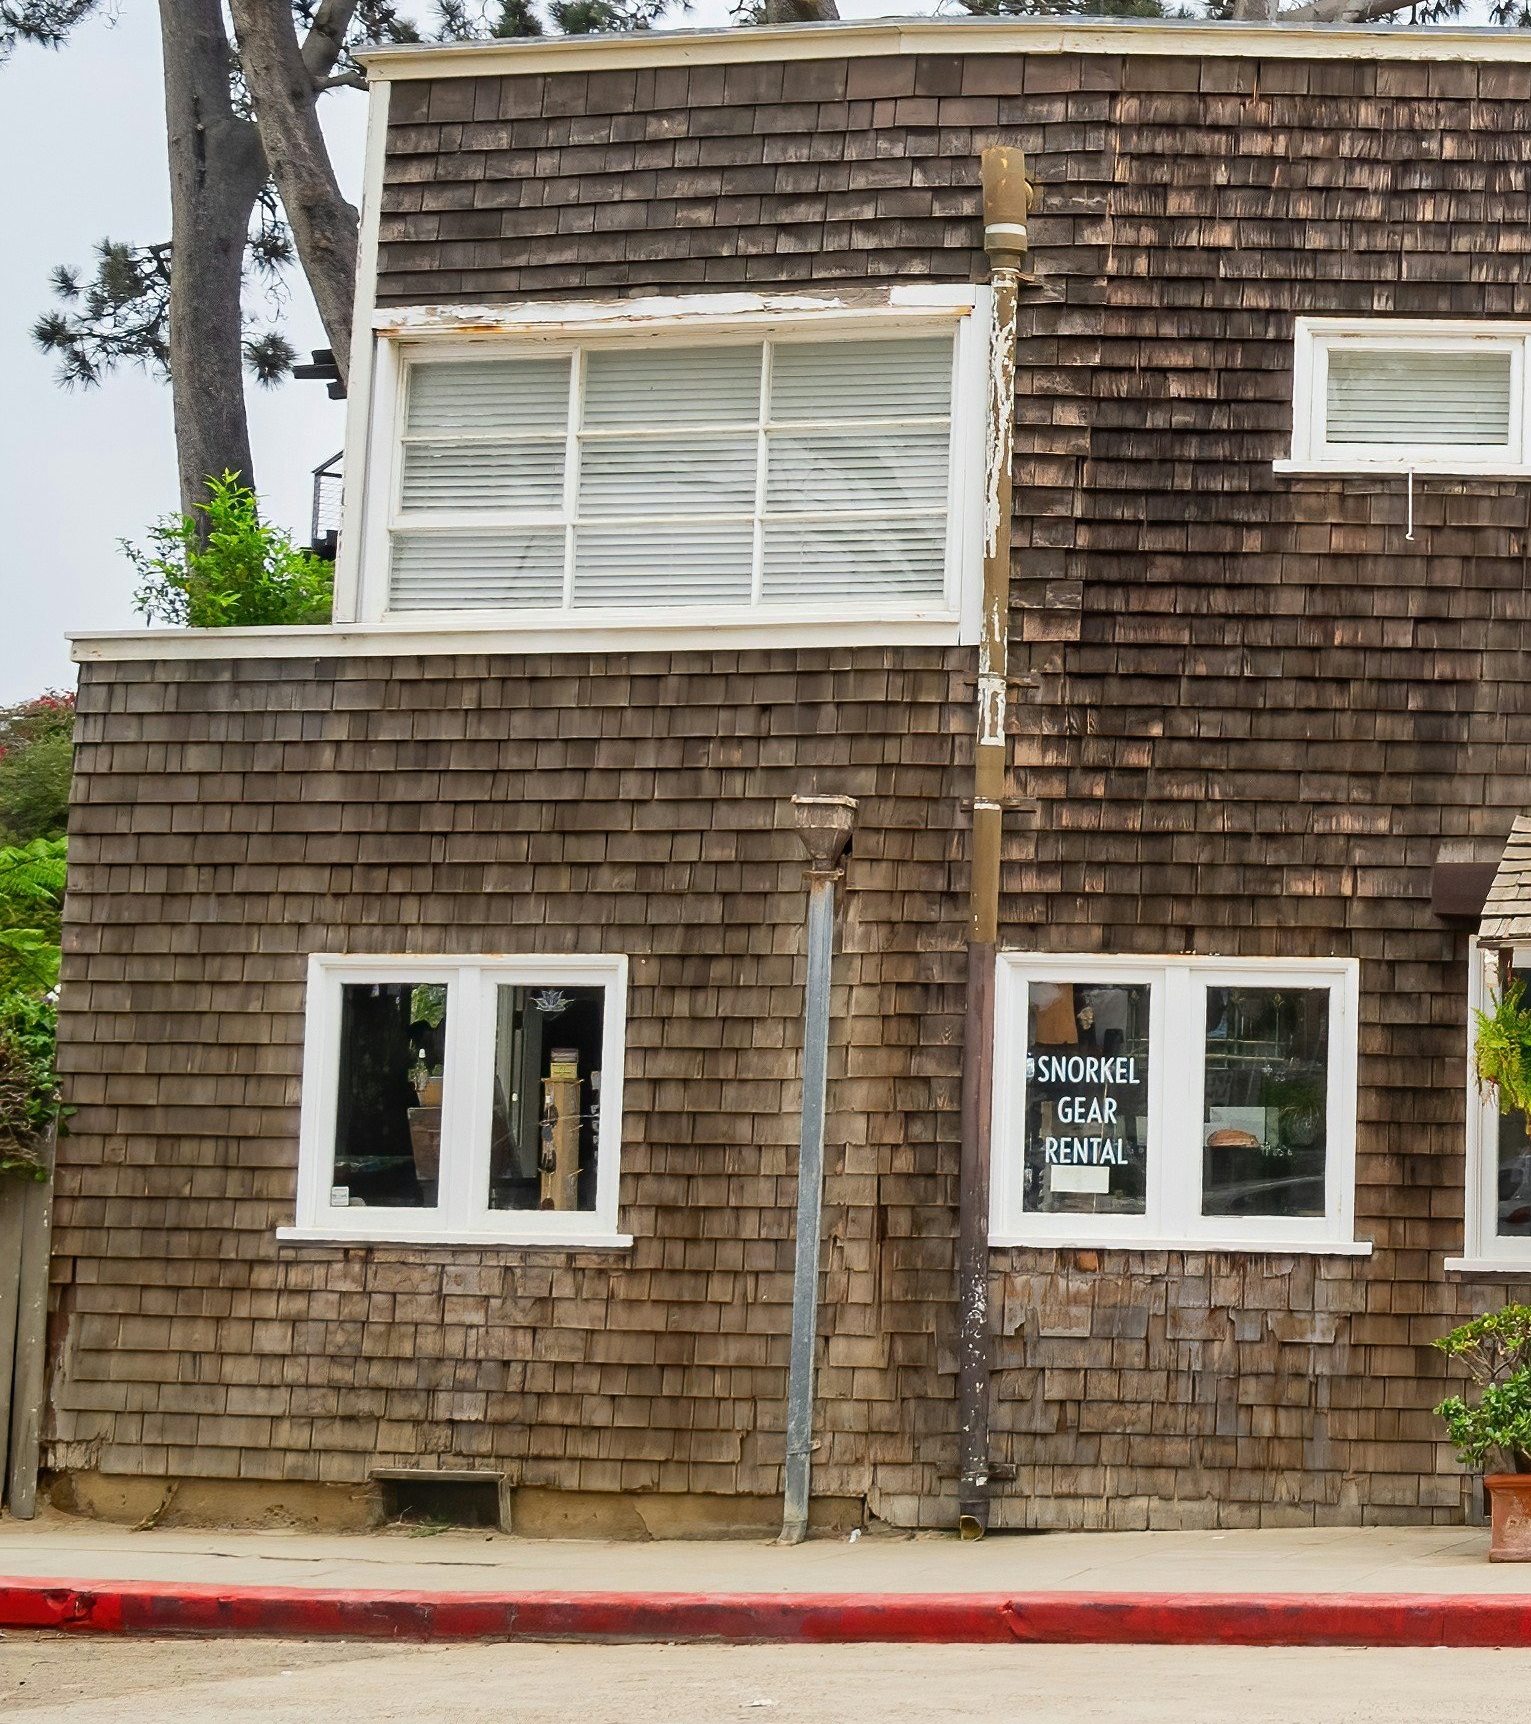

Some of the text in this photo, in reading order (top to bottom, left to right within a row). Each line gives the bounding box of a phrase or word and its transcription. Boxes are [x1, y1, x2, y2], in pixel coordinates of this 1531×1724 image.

[1037, 1054, 1141, 1085] SNORKEL
[1057, 1096, 1118, 1126] GEAR
[1044, 1136, 1129, 1166] RENTAL
